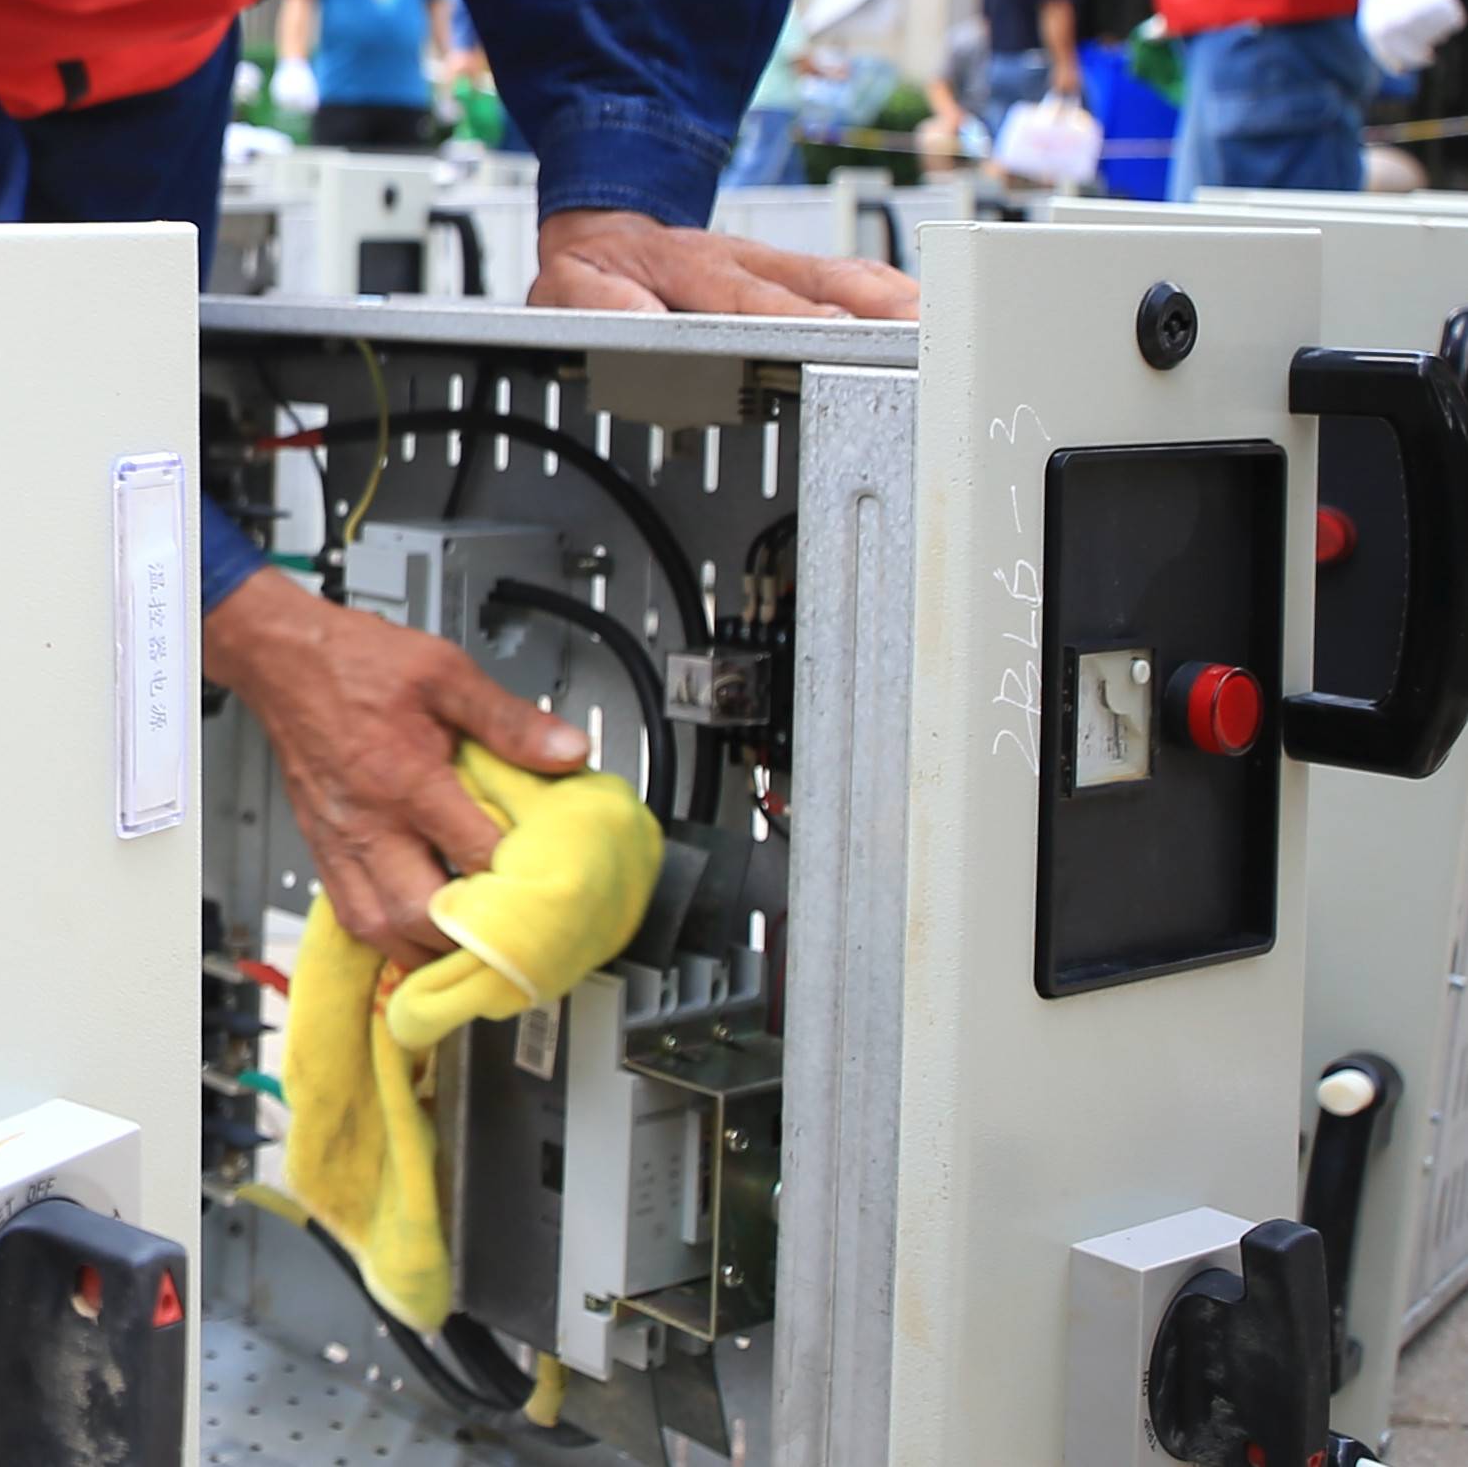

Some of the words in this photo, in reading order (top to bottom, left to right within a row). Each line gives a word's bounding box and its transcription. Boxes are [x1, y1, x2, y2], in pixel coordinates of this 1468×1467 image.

[146, 561, 170, 733] 温控器电源
[26, 1176, 57, 1204] OFF
